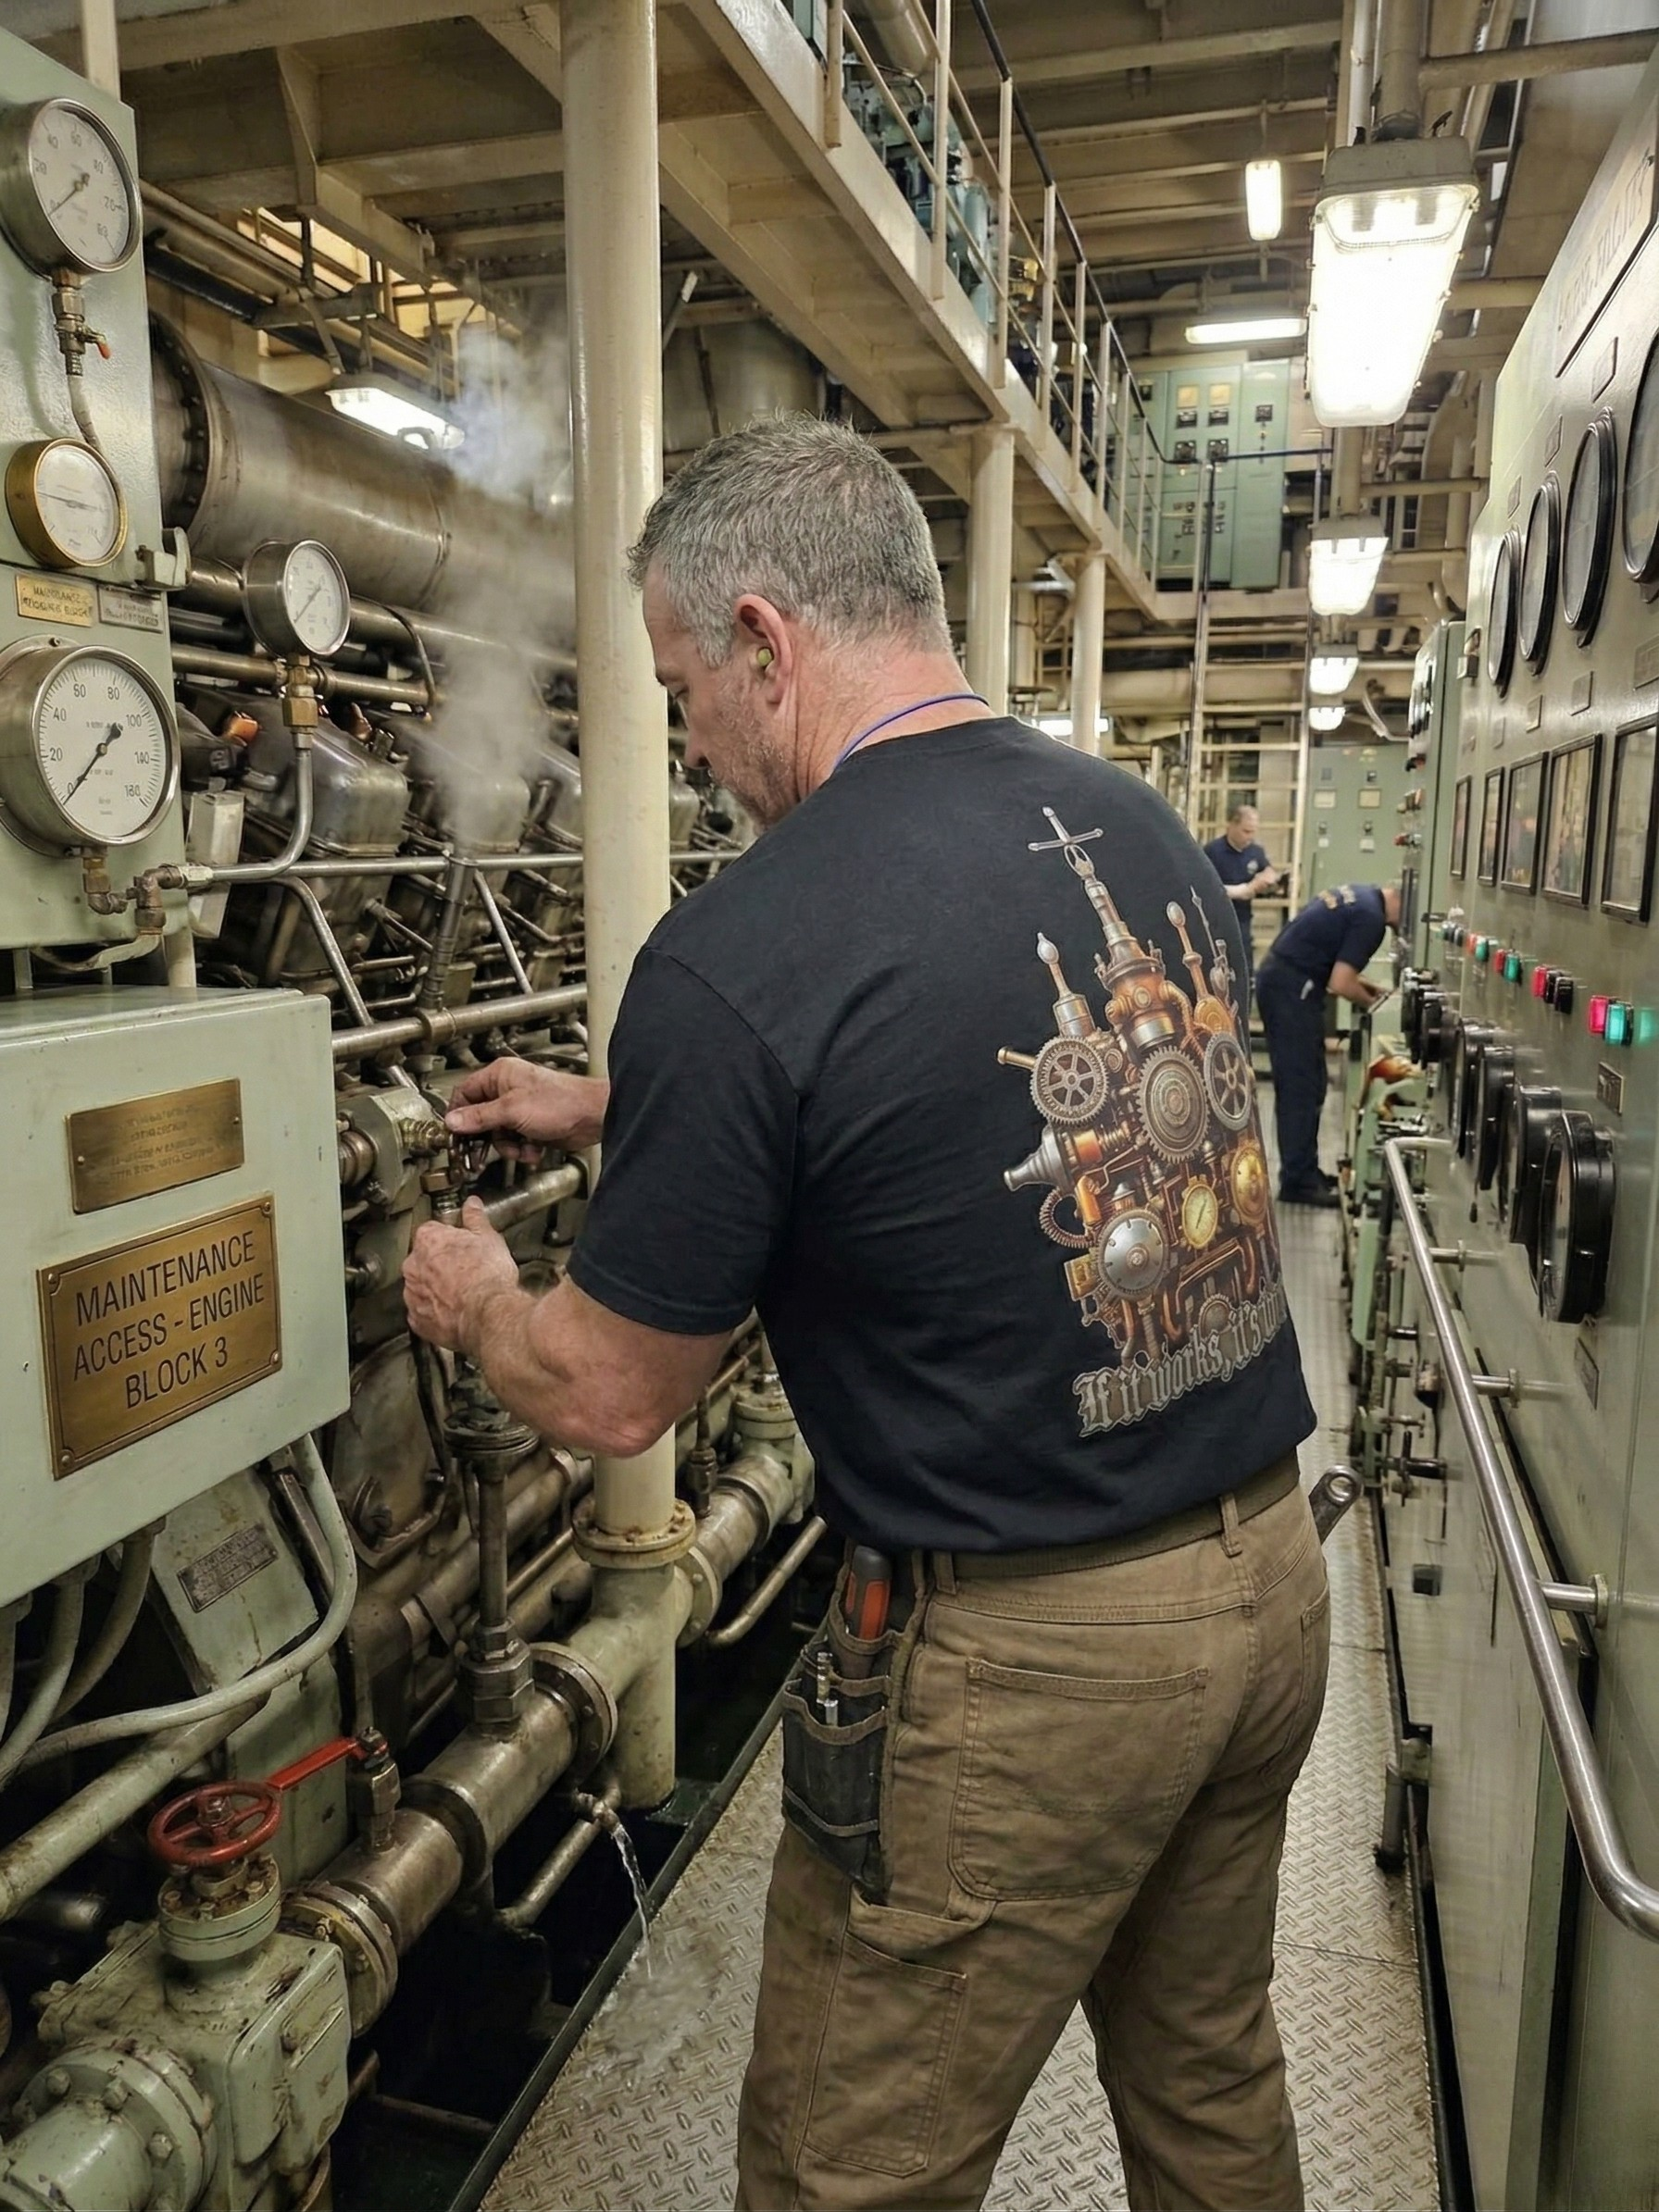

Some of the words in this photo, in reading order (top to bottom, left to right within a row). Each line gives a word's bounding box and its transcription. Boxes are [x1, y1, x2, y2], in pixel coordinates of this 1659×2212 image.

[53, 707, 66, 721] 40
[126, 714, 142, 727] 100
[50, 747, 63, 761] 20
[75, 1230, 256, 1327] MAINTENANCE
[74, 1311, 168, 1381] ACCESS
[190, 1273, 266, 1332] ENGINE
[126, 1342, 208, 1410] BLOCK
[214, 1336, 229, 1369] 3
[1074, 1371, 1111, 1435] If
[1117, 1369, 1144, 1420] it
